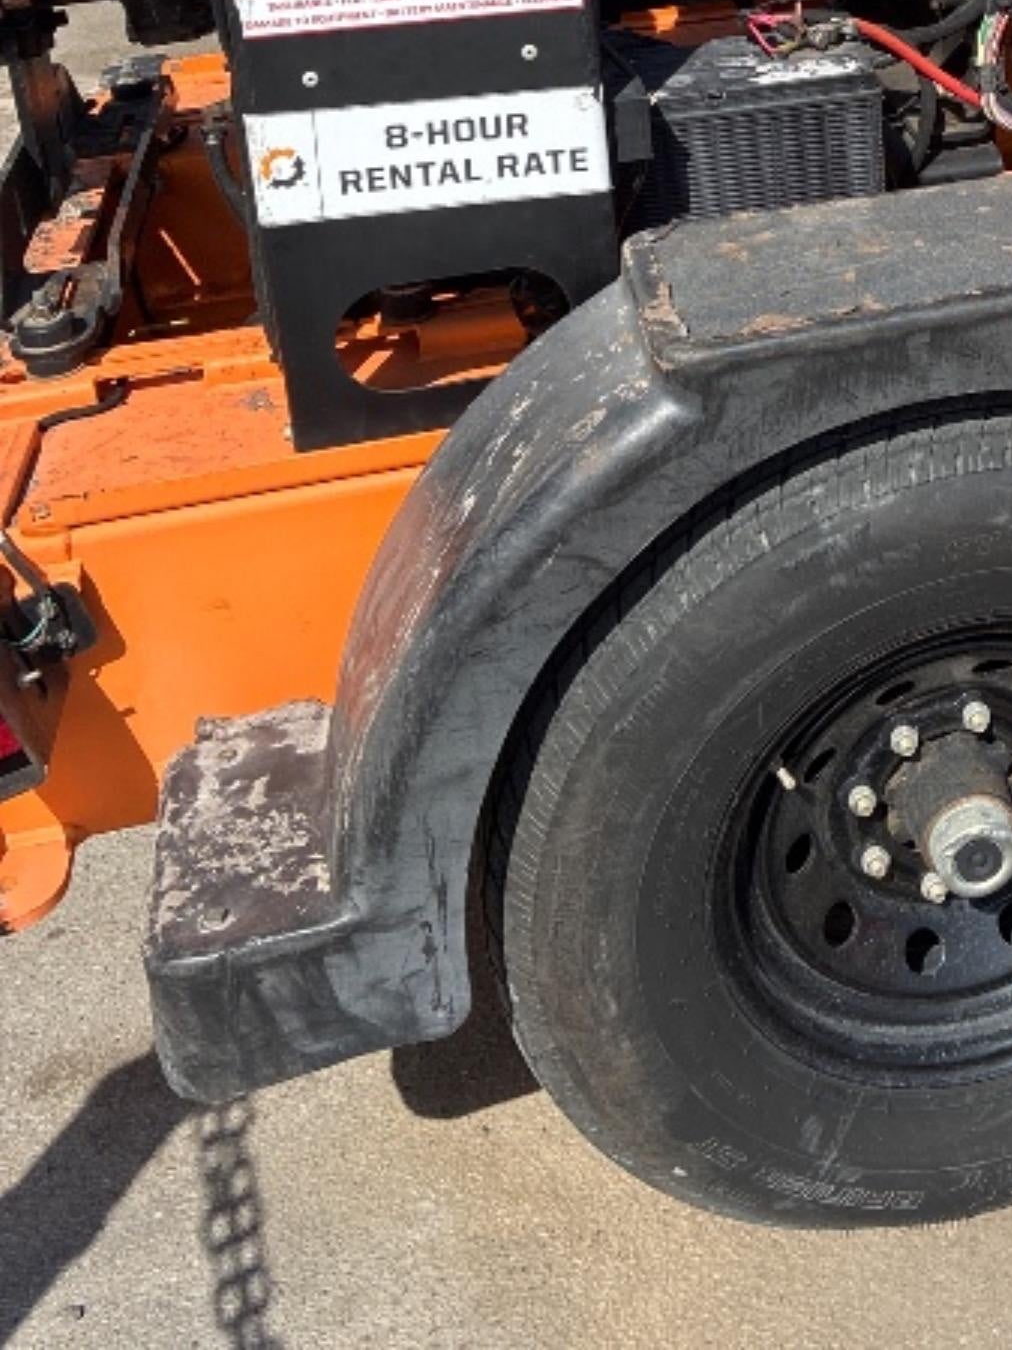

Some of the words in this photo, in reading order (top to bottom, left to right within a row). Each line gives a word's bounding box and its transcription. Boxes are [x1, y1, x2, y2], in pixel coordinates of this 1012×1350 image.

[385, 112, 529, 149] 8-HOUR
[339, 159, 482, 196] RENTAL
[496, 147, 588, 179] RATE
